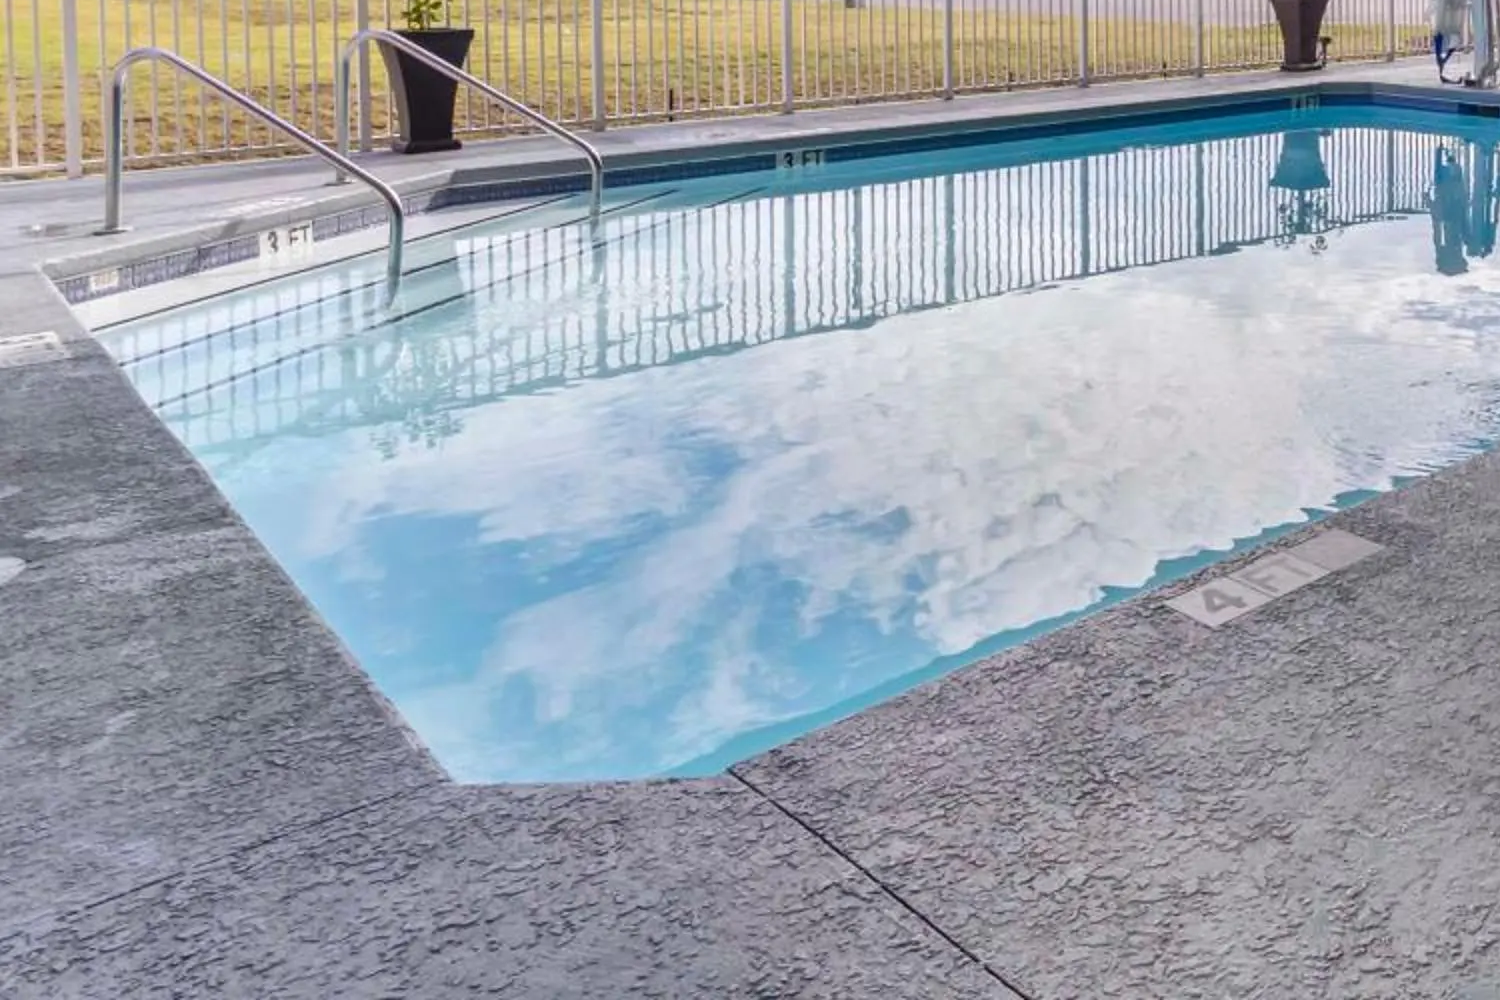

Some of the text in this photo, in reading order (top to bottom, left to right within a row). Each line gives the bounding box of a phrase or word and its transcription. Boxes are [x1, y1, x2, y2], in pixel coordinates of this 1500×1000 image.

[802, 149, 823, 167] FT
[267, 224, 311, 253] 3 FT
[1202, 555, 1315, 614] 4 FT
